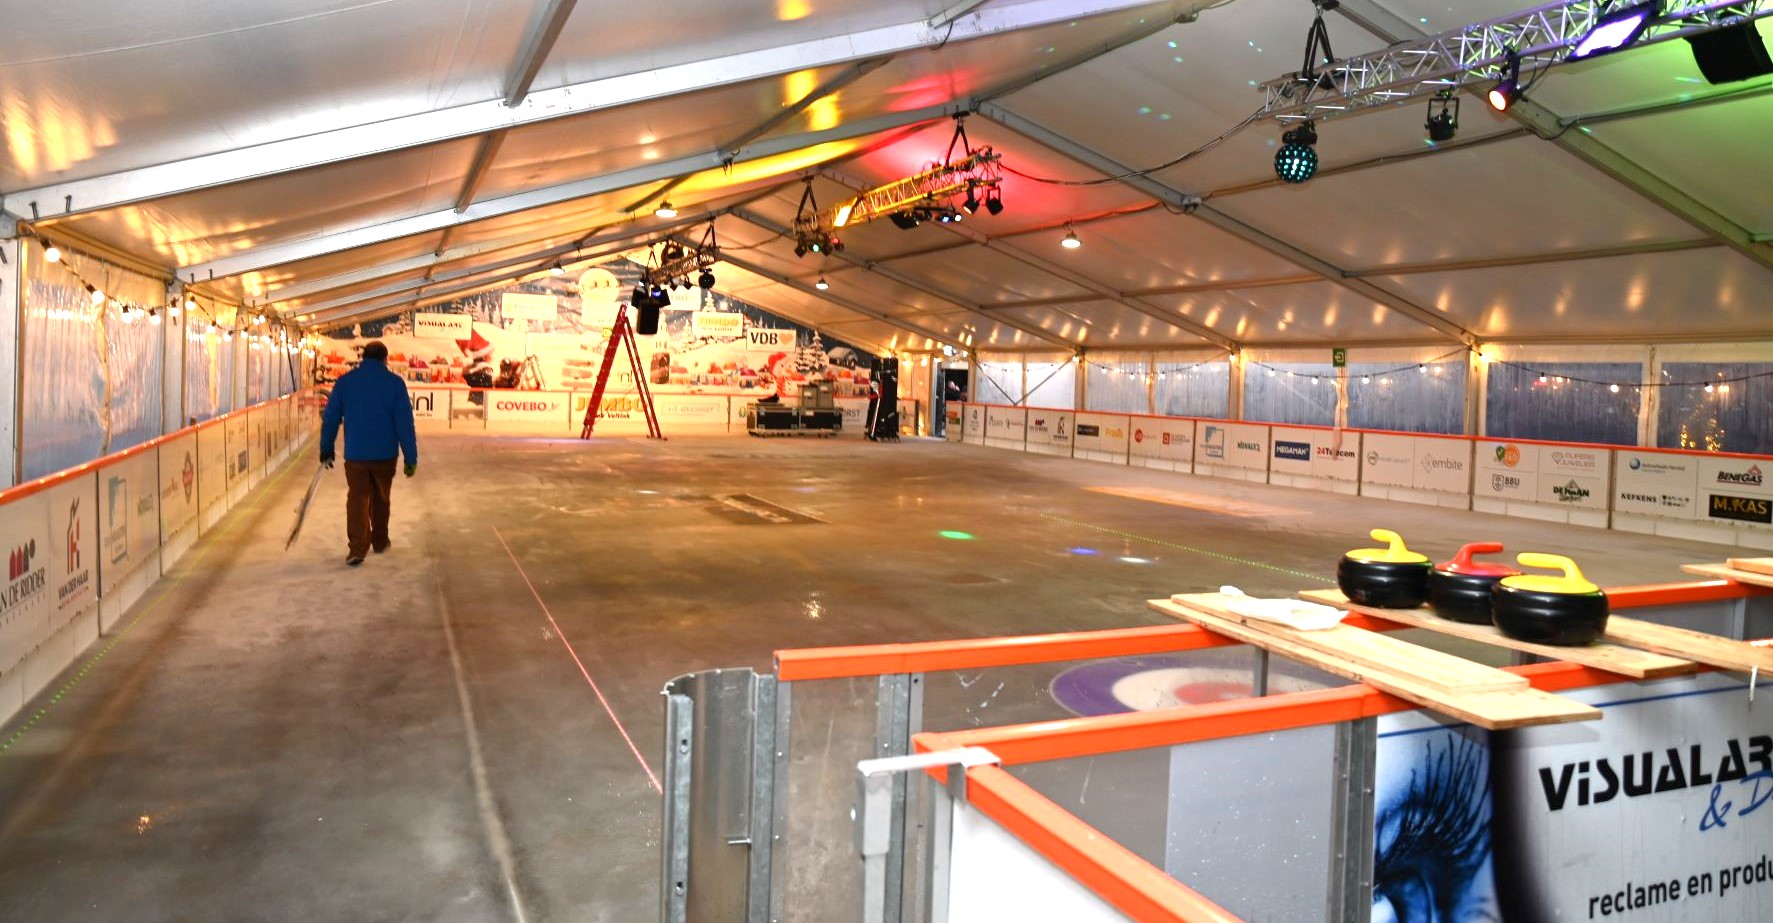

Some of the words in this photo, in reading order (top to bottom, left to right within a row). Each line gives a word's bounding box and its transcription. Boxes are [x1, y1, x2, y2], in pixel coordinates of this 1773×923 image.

[750, 332, 778, 345] VDB
[497, 401, 547, 411] COVEBO
[1276, 445, 1306, 455] MEGAMAN
[1432, 458, 1463, 470] embite
[1717, 471, 1763, 484] BENEGAS
[1700, 783, 1732, 830] &
[1589, 882, 1681, 919] reclame
[1687, 872, 1713, 896] en
